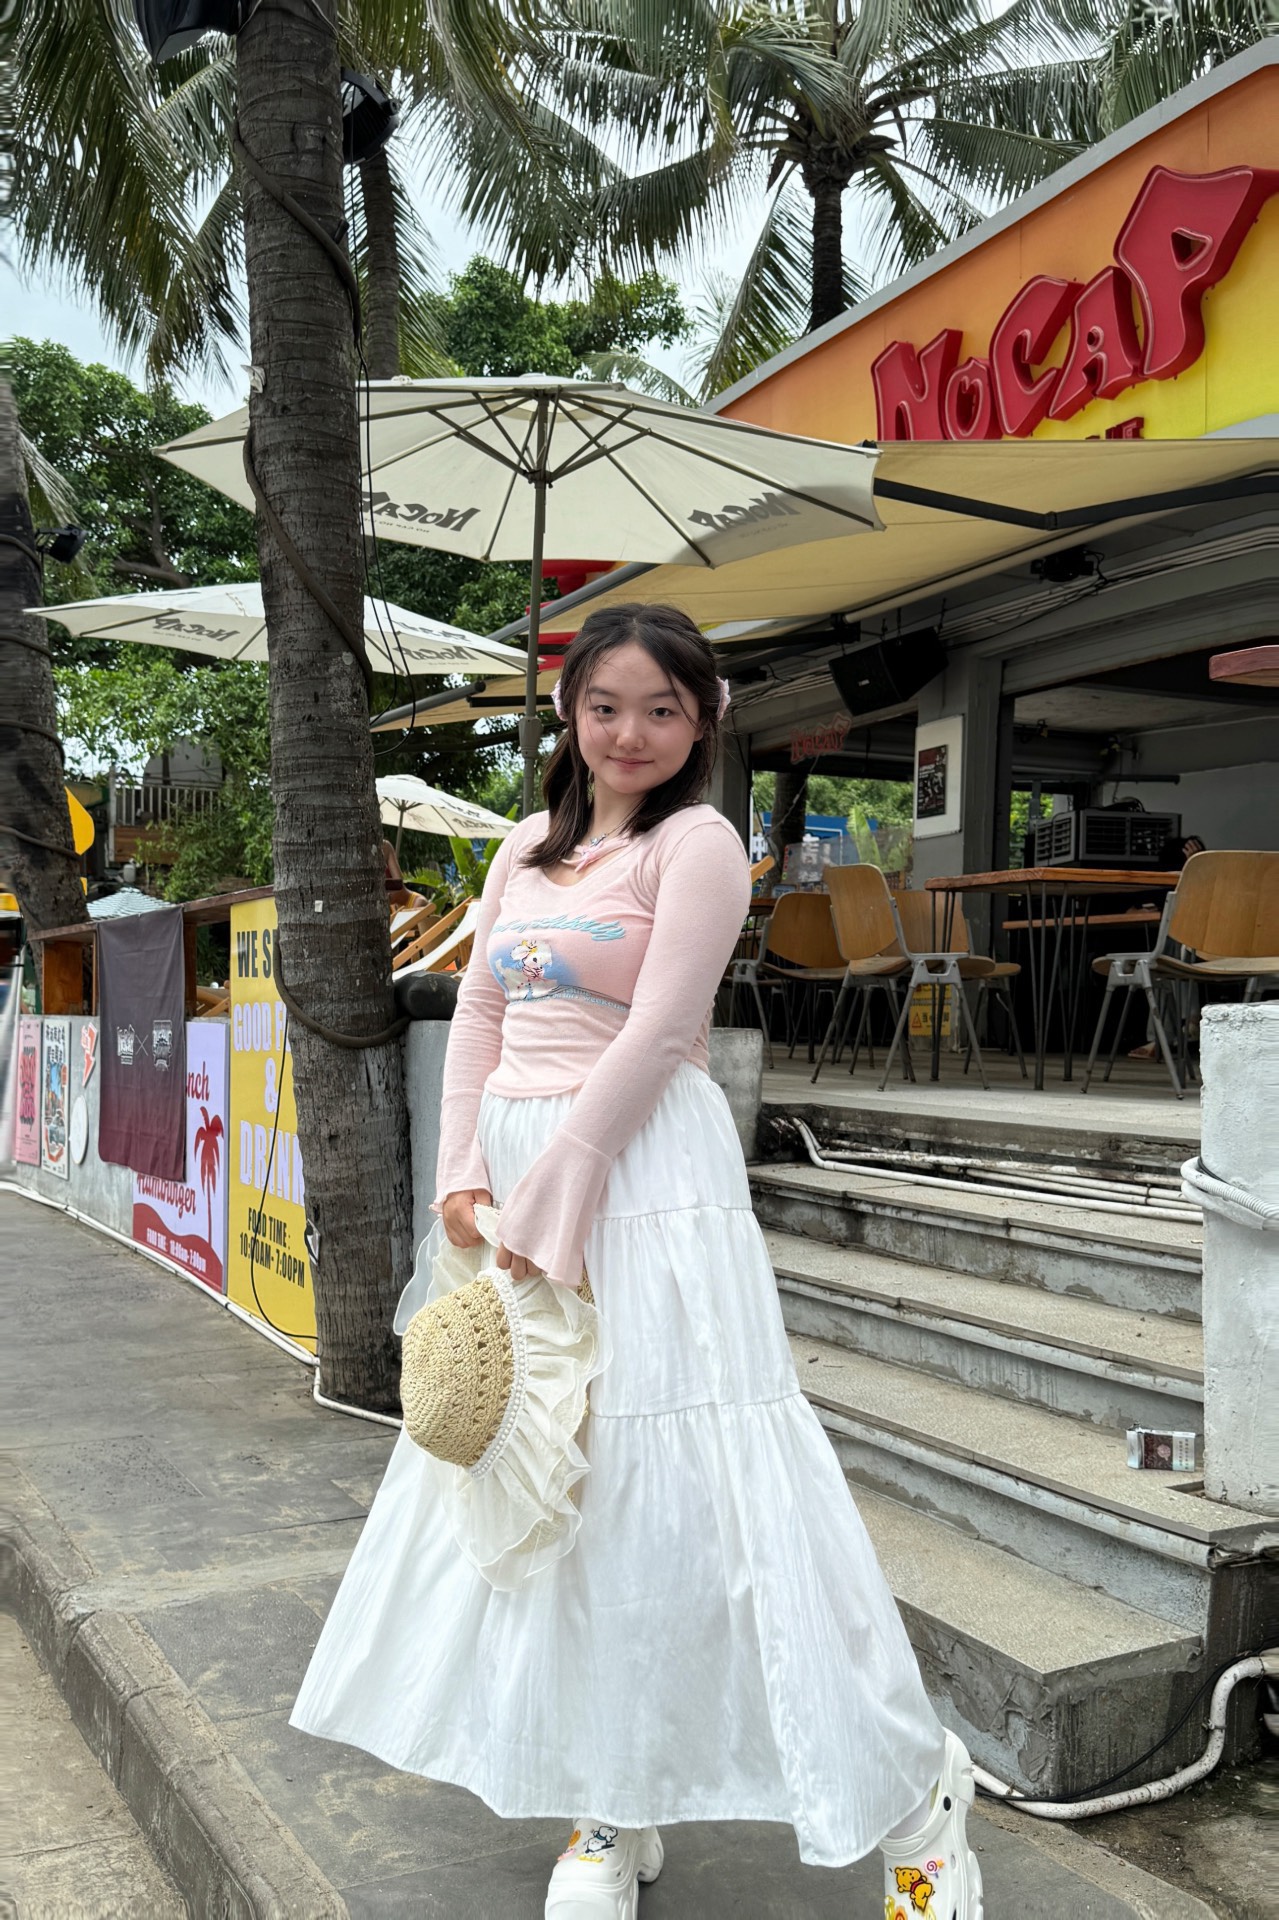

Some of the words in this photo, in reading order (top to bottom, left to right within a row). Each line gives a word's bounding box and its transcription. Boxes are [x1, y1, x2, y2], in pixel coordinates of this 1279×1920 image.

[236, 930, 258, 978] WE
[233, 1001, 272, 1052] GOOD
[248, 1207, 267, 1238] FOOD
